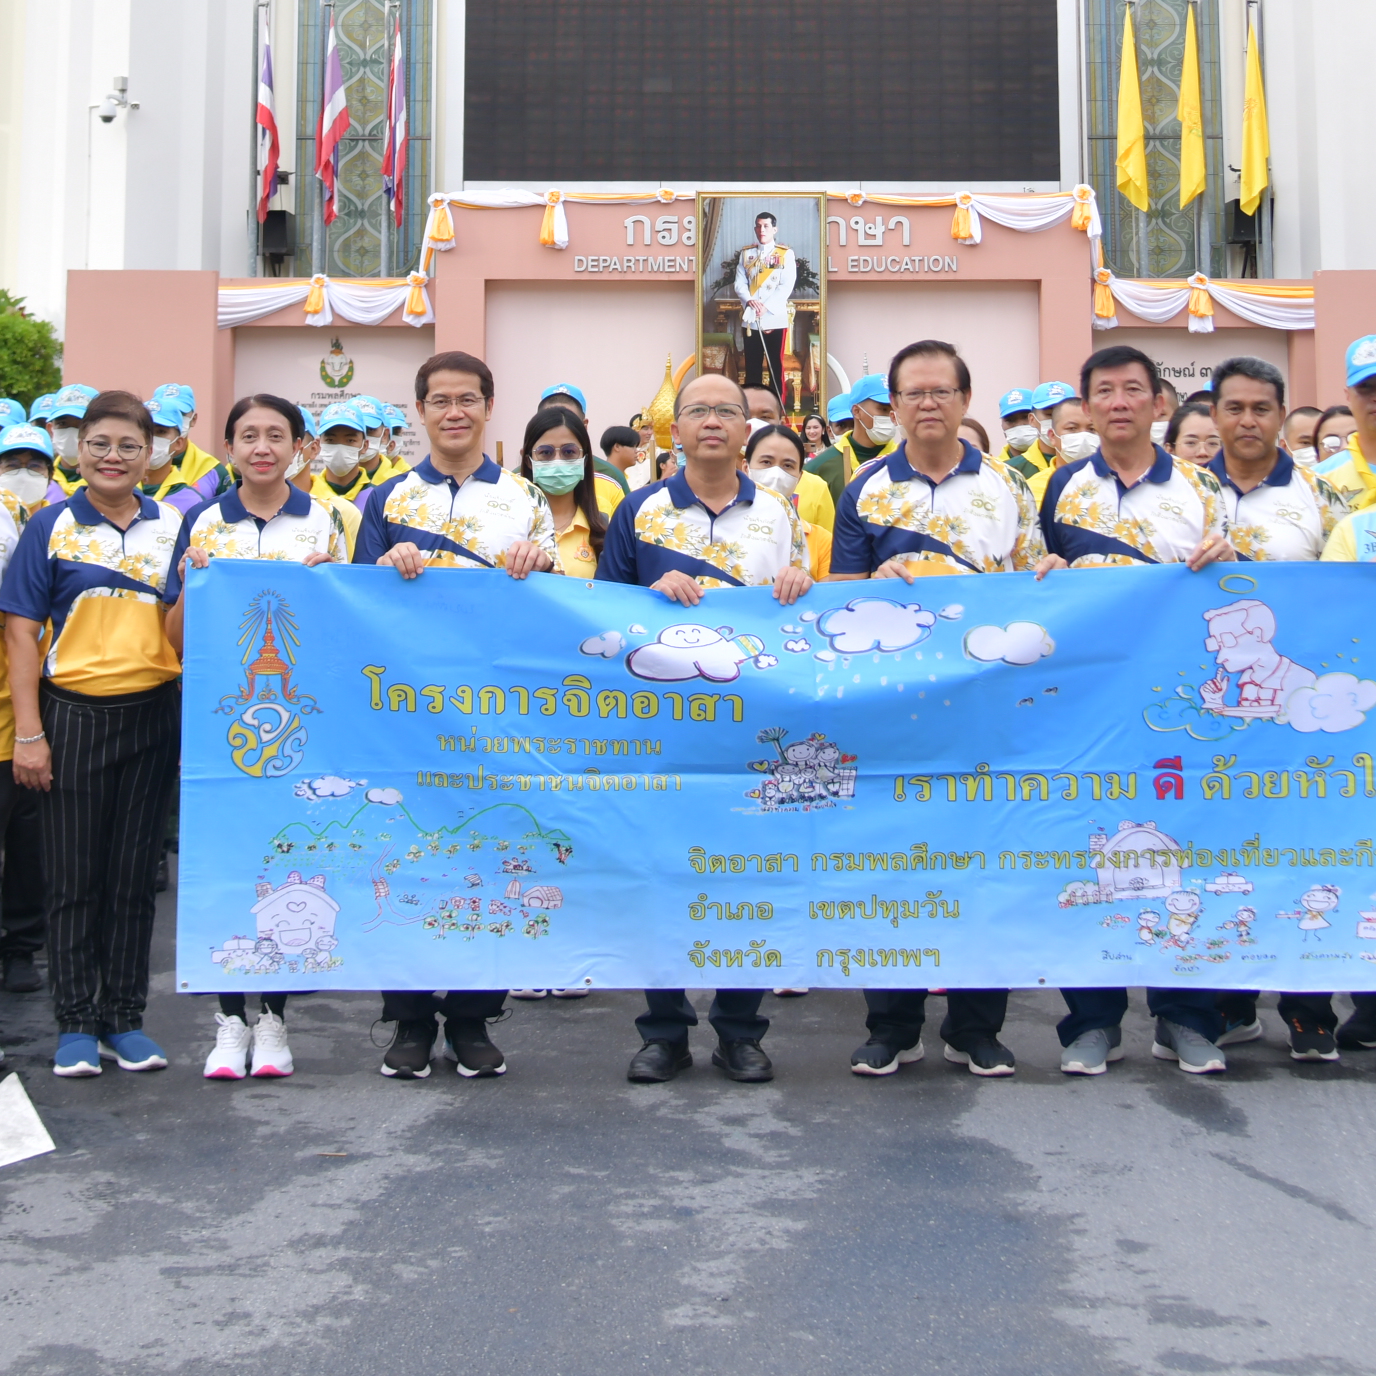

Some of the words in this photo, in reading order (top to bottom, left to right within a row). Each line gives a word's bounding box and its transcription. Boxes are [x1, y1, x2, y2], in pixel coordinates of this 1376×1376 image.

[847, 255, 957, 273] EDUCATION
[361, 663, 745, 723] โครงการจิตอาสา
[436, 725, 663, 756] หน่วยพระราชทาน
[416, 764, 683, 792] และประชาชนจิตอาสา
[893, 762, 1138, 802] เราทำความ
[1152, 755, 1184, 801] ดี
[687, 846, 800, 874] จิตอาสา
[810, 841, 986, 872] กรมพลศึกษา
[687, 893, 774, 921] อำเภอ
[808, 890, 960, 928] เขตปทุมวัน
[687, 939, 783, 968] จังหวัด
[816, 947, 941, 977] กรุงเทพฯ
